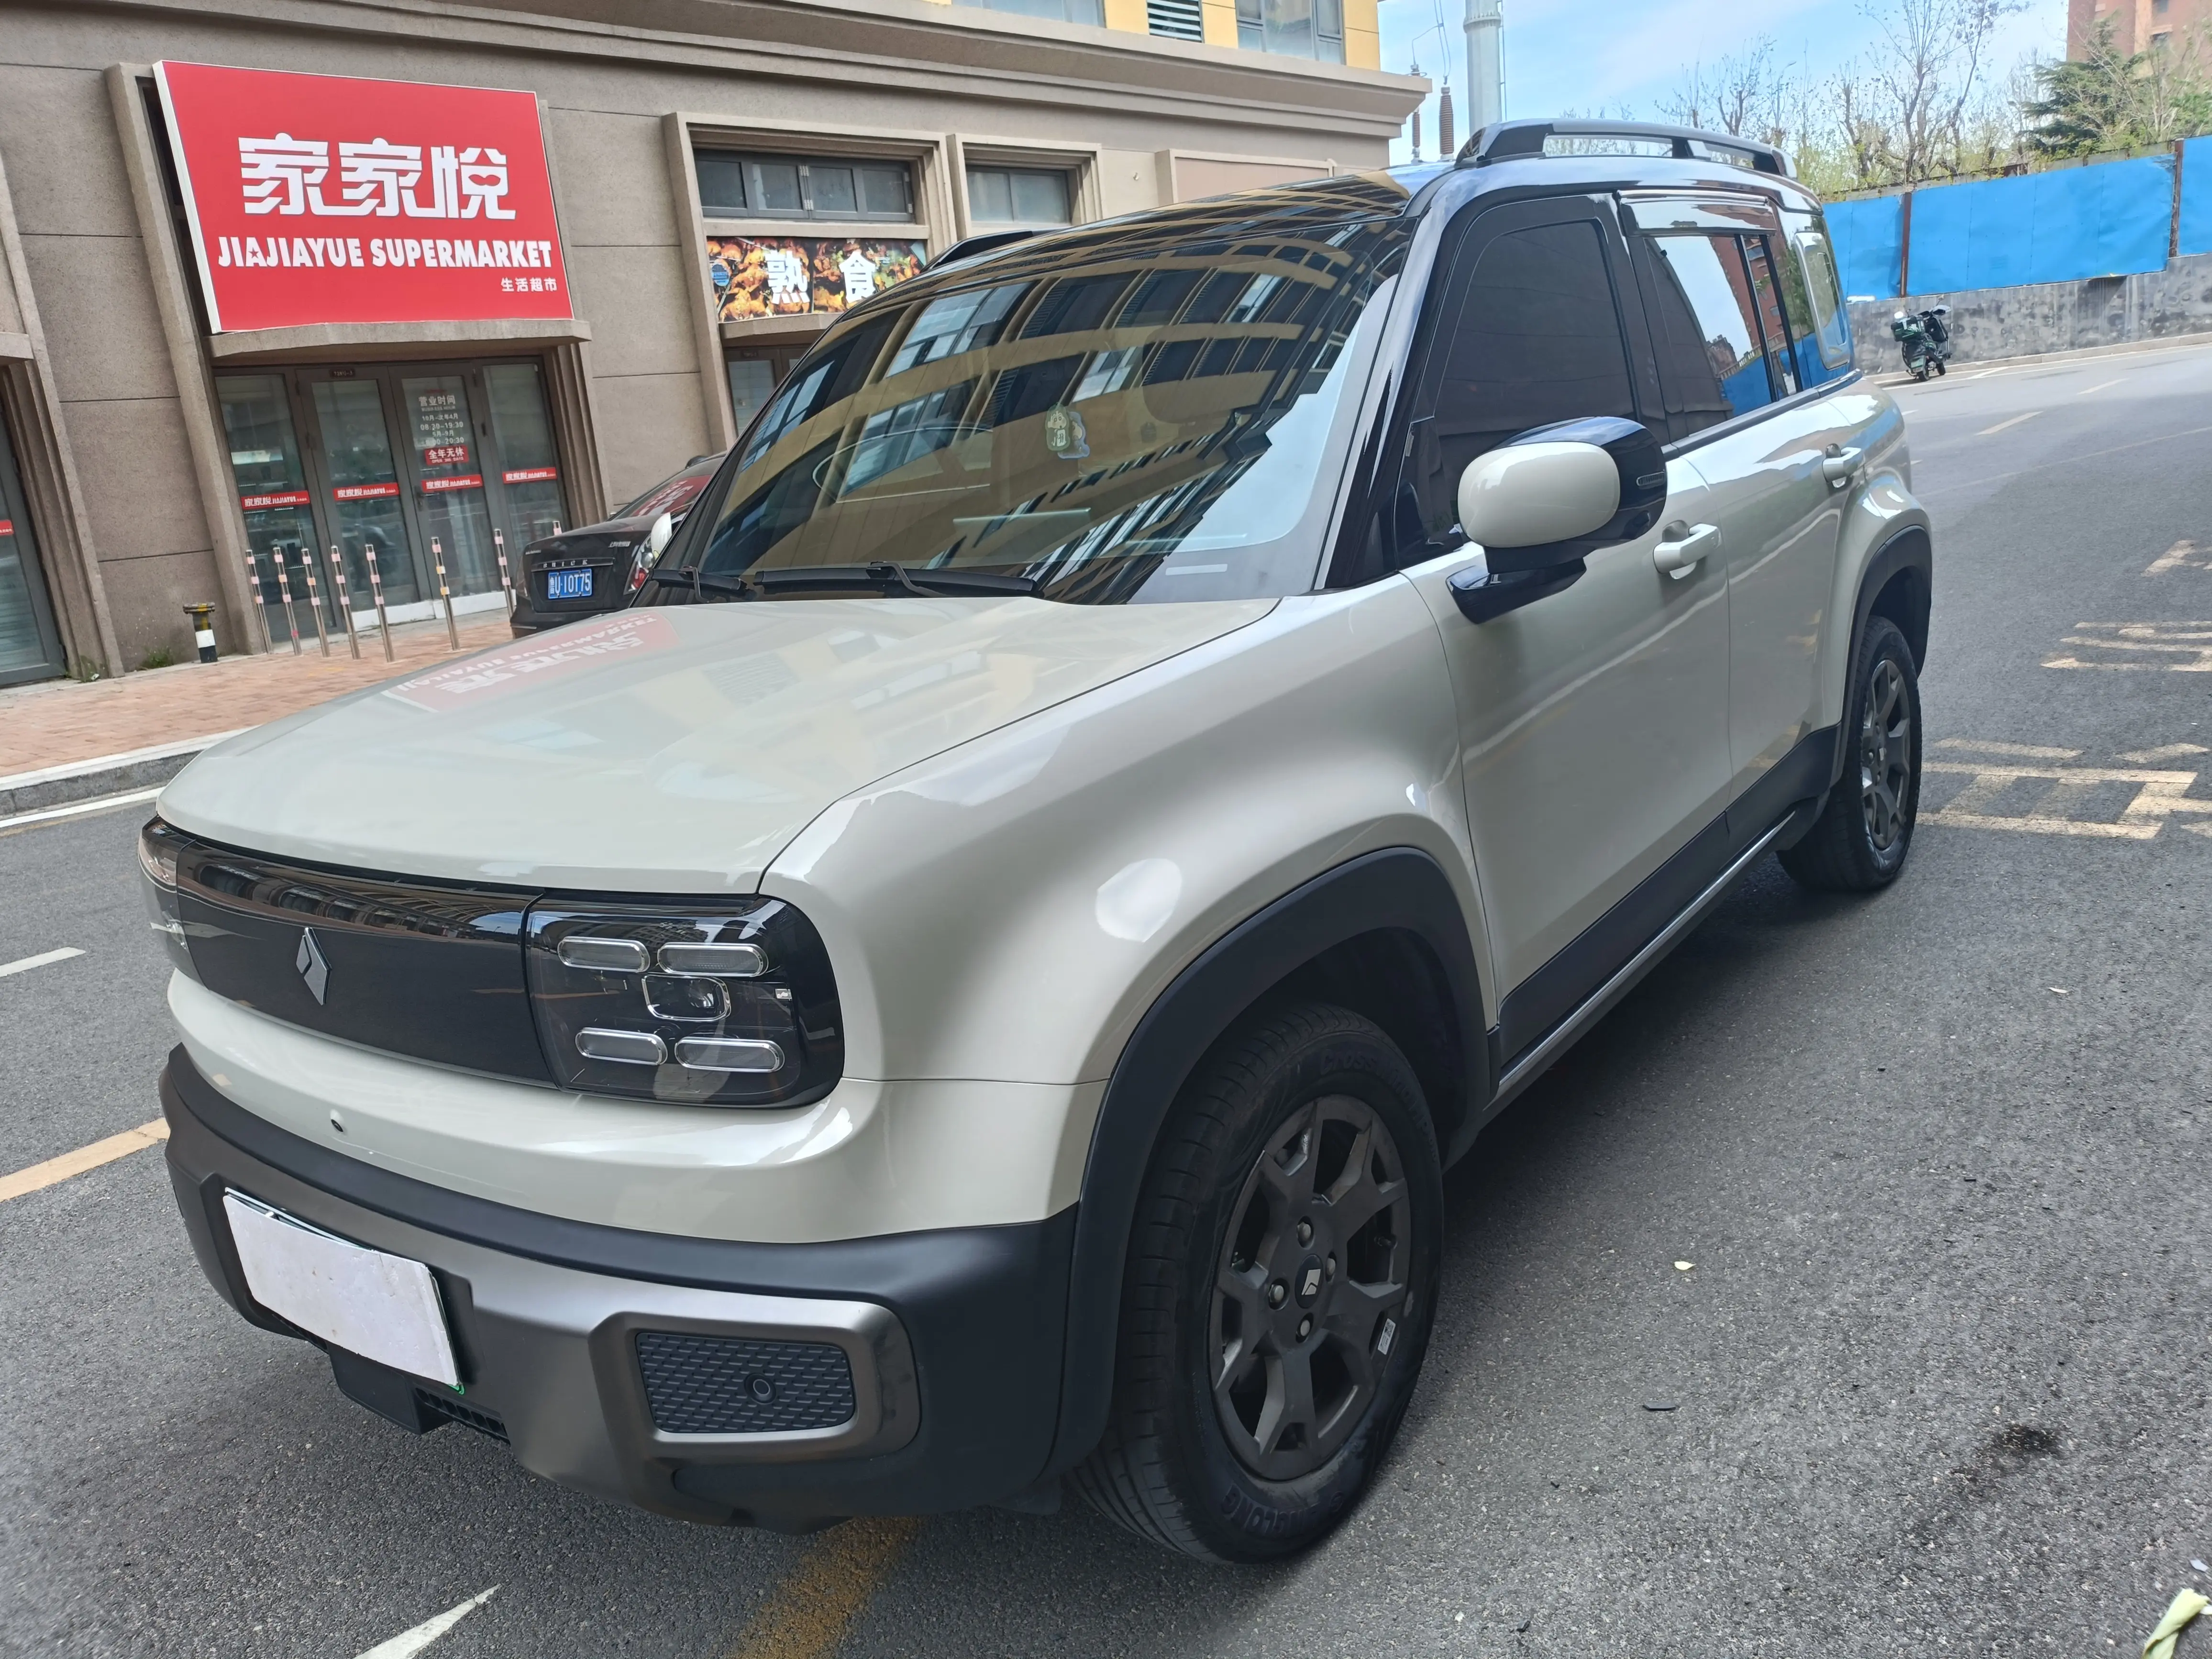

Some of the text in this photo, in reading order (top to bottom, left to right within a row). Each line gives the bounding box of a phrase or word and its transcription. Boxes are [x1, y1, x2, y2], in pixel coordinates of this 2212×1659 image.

[238, 133, 516, 220] 家家悦
[218, 236, 552, 268] JIAJIAYUE SUPERMARKET
[500, 277, 557, 292] 生活超市
[765, 250, 875, 305] 熟食
[419, 395, 455, 406] 营业时间
[429, 446, 464, 459] 全年无休
[244, 496, 272, 507] 家家悦
